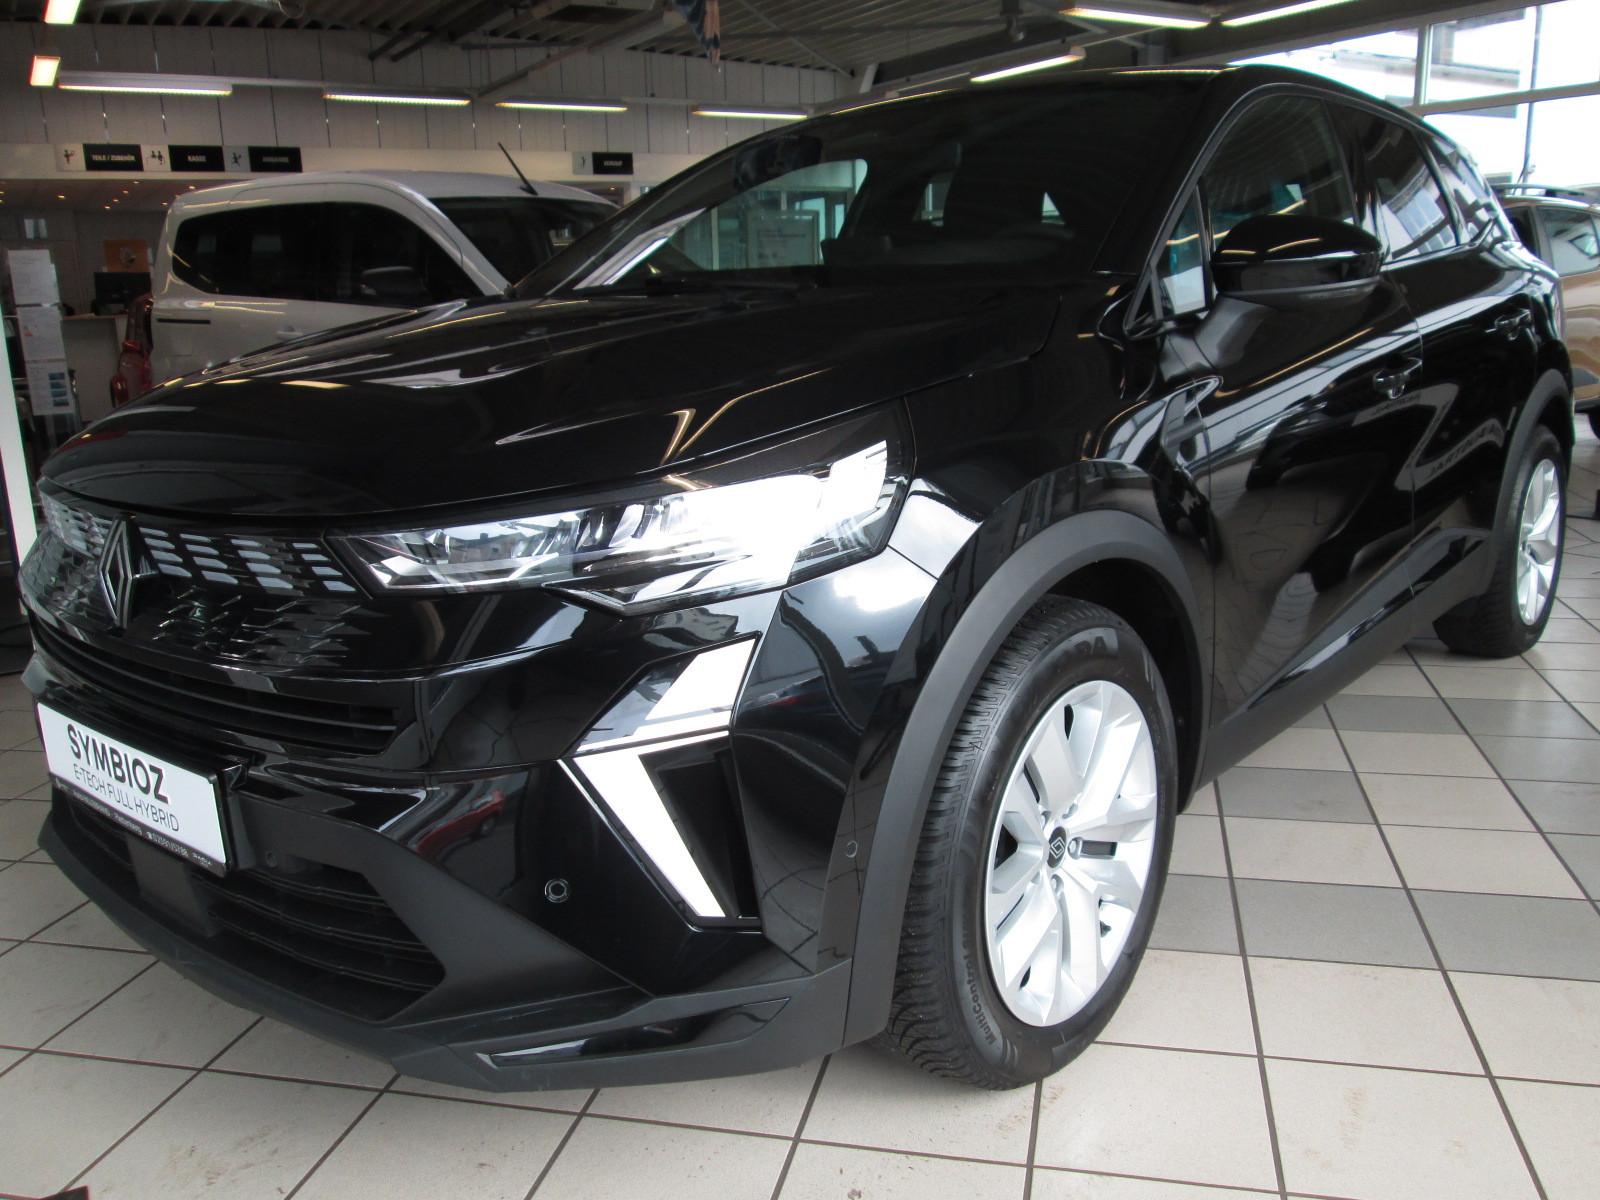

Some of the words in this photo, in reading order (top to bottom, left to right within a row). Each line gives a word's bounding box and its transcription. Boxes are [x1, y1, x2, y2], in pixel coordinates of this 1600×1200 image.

[67, 723, 169, 805] SYMBIOZ
[73, 763, 107, 797] E-TECH
[107, 783, 133, 810] FULL
[134, 797, 180, 832] HYBRID
